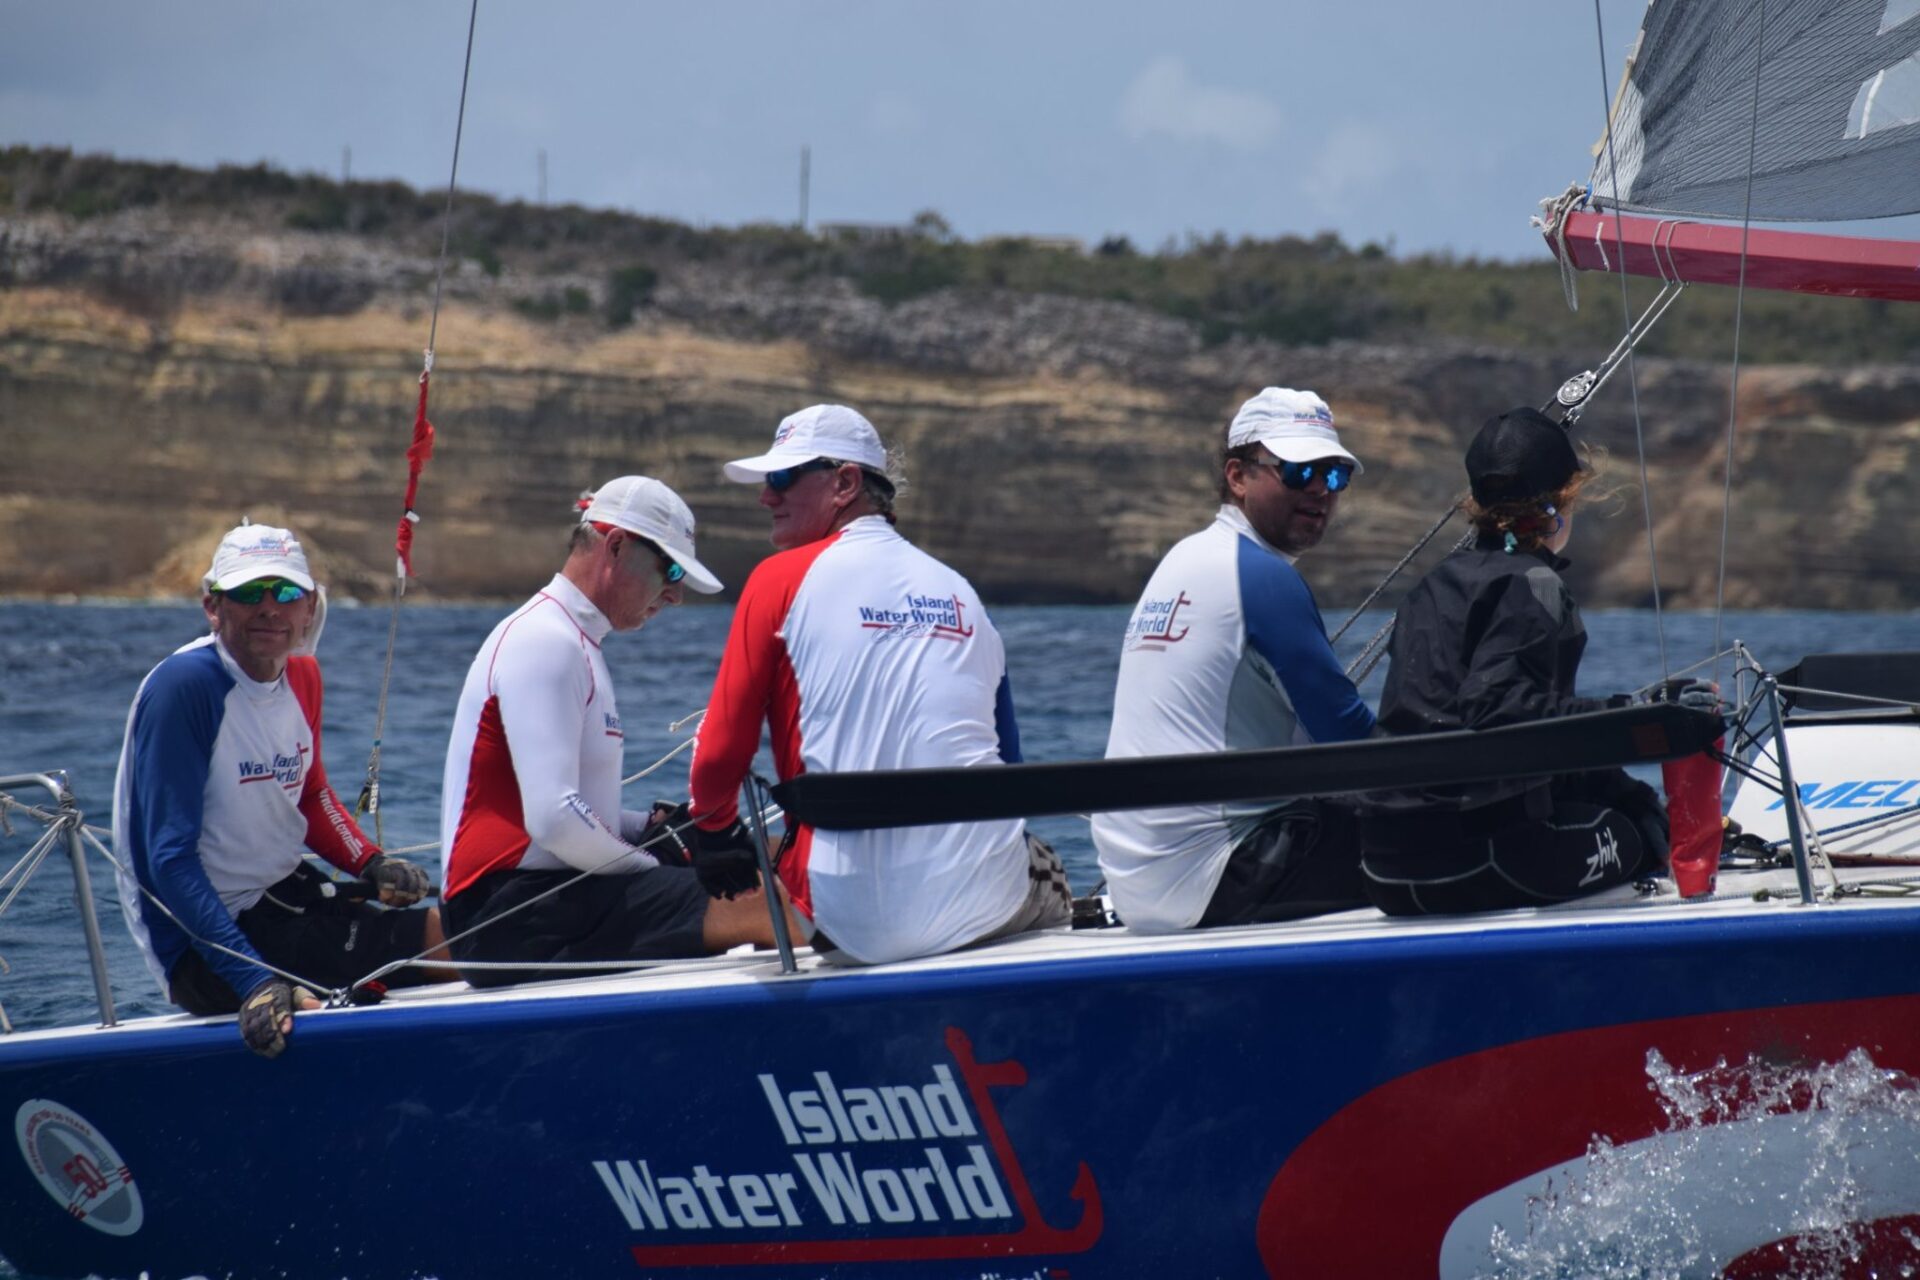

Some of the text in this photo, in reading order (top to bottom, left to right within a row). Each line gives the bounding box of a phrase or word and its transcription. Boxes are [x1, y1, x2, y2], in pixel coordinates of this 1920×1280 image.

[859, 607, 956, 626] Water World
[907, 595, 955, 611] Island
[1764, 780, 1920, 811] MEL
[758, 1064, 978, 1145] Island
[592, 1145, 1012, 1230] Water World
